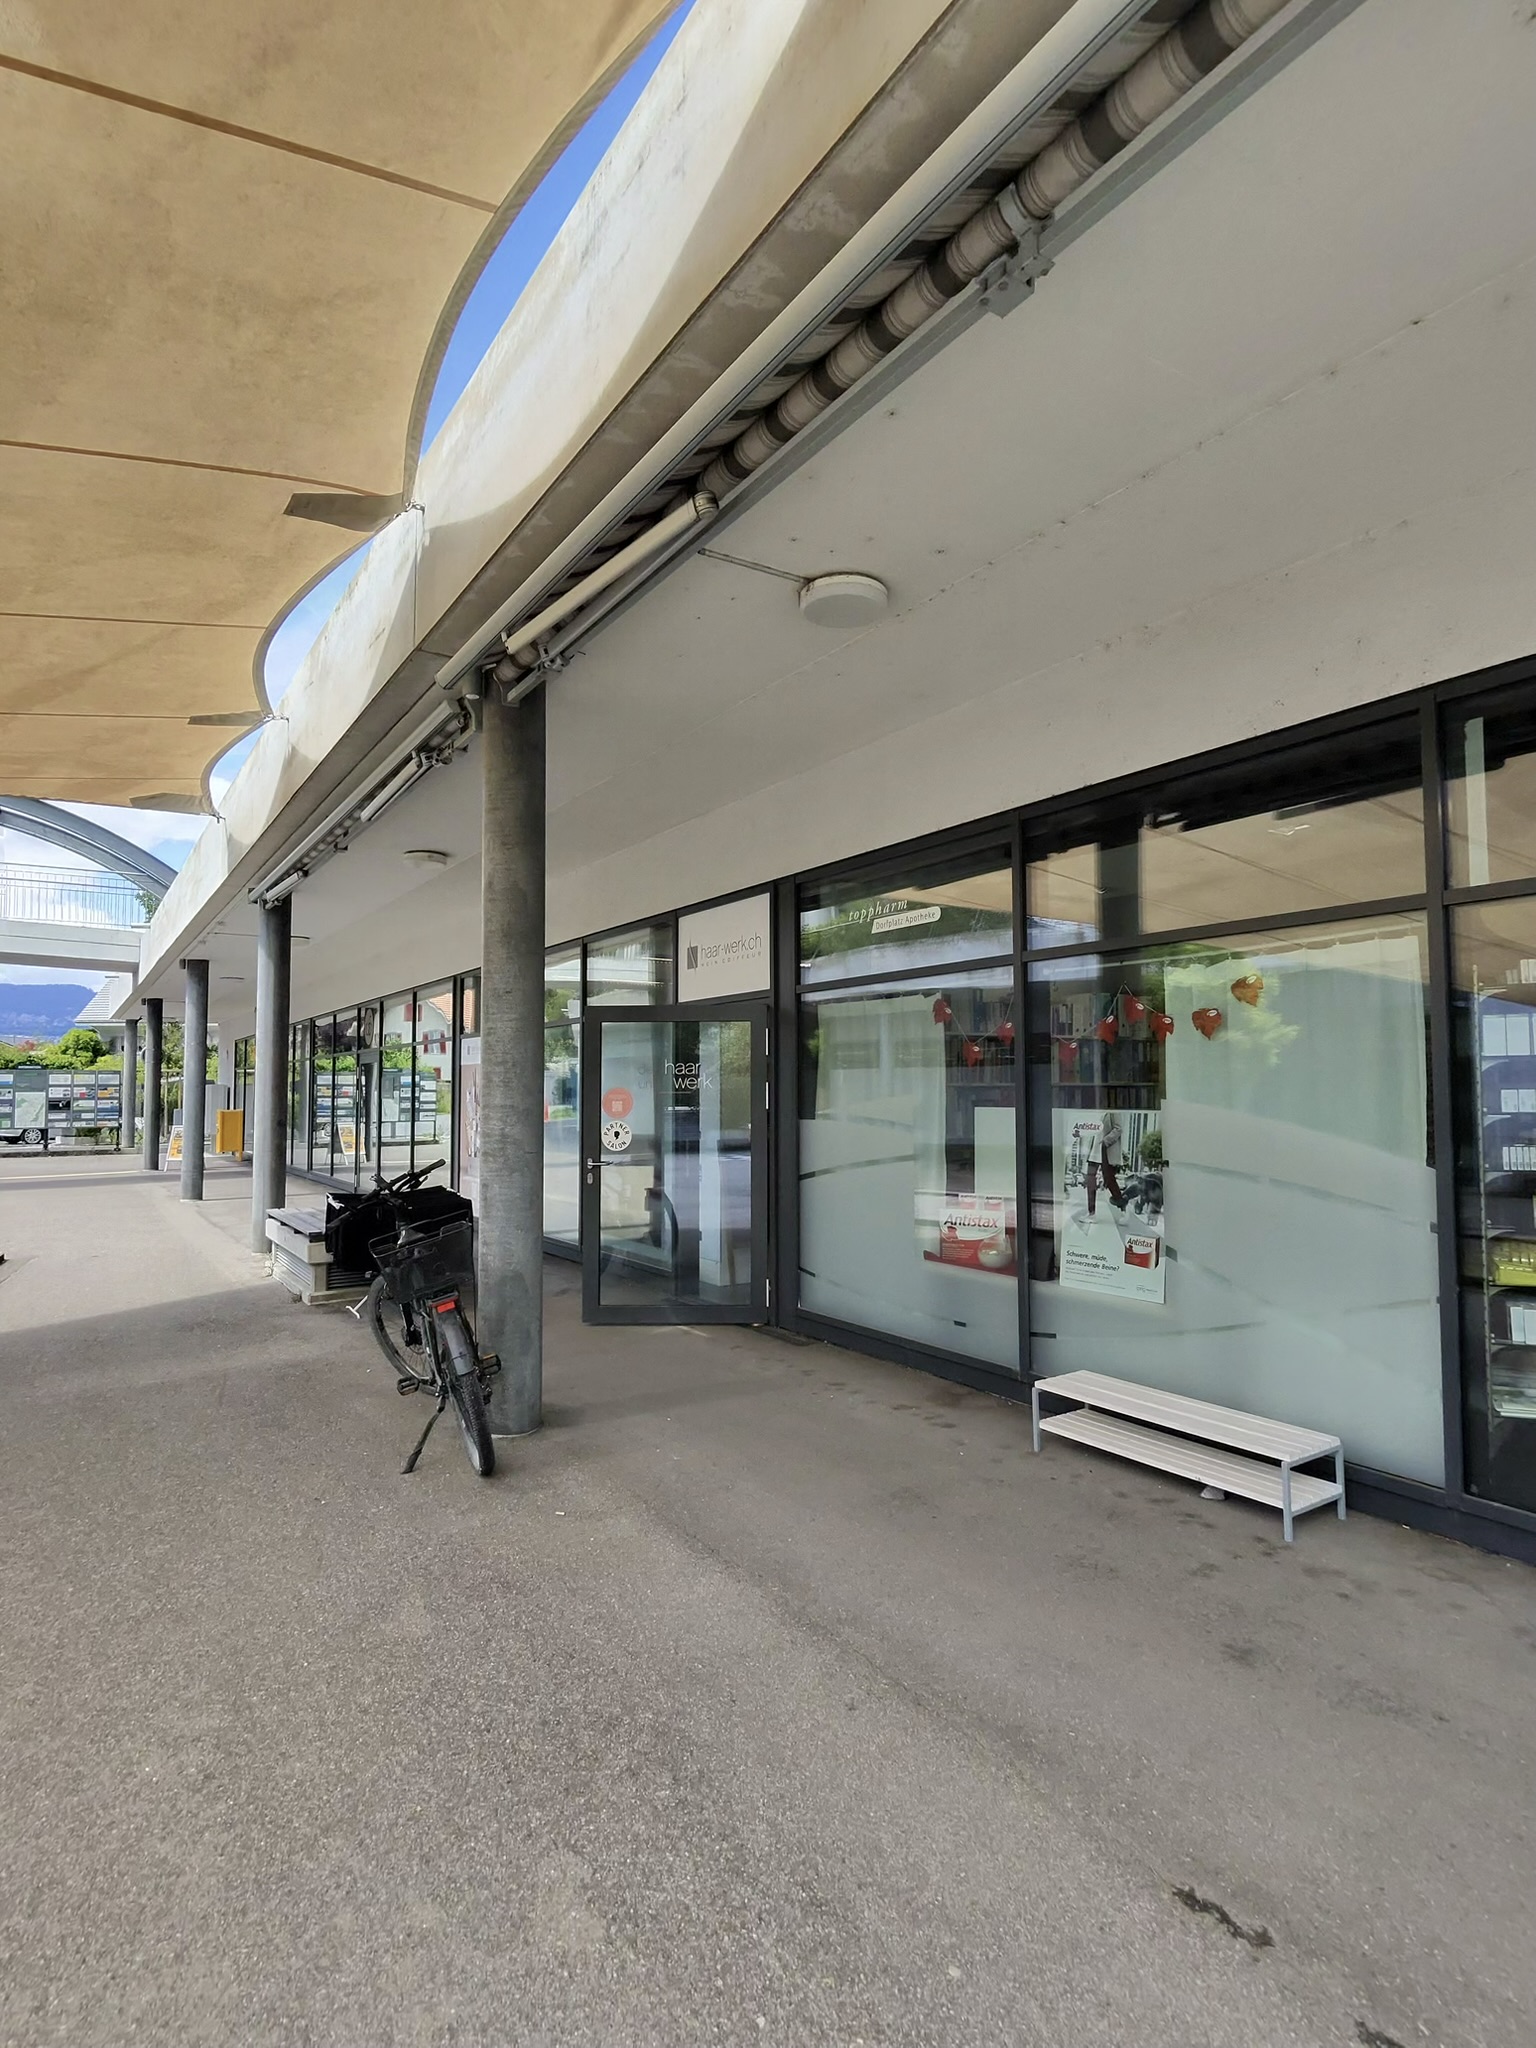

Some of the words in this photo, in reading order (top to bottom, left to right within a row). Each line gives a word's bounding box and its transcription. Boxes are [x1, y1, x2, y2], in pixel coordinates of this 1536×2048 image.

[848, 899, 908, 923] toppharm
[875, 917, 904, 931] Dorfplatz
[905, 911, 937, 925] Apotheke
[701, 931, 762, 960] haar-werk.ch
[664, 1059, 701, 1075] haar
[673, 1073, 713, 1089] werk
[603, 1122, 630, 1136] PARTNER
[606, 1140, 627, 1149] SALON
[944, 1213, 998, 1228] Antistax
[1127, 1237, 1153, 1248] Antistax
[1066, 1250, 1090, 1260] Schwere,
[1091, 1254, 1108, 1263] müde,
[1065, 1259, 1100, 1269] schmerzende
[1101, 1263, 1120, 1272] Beine?
